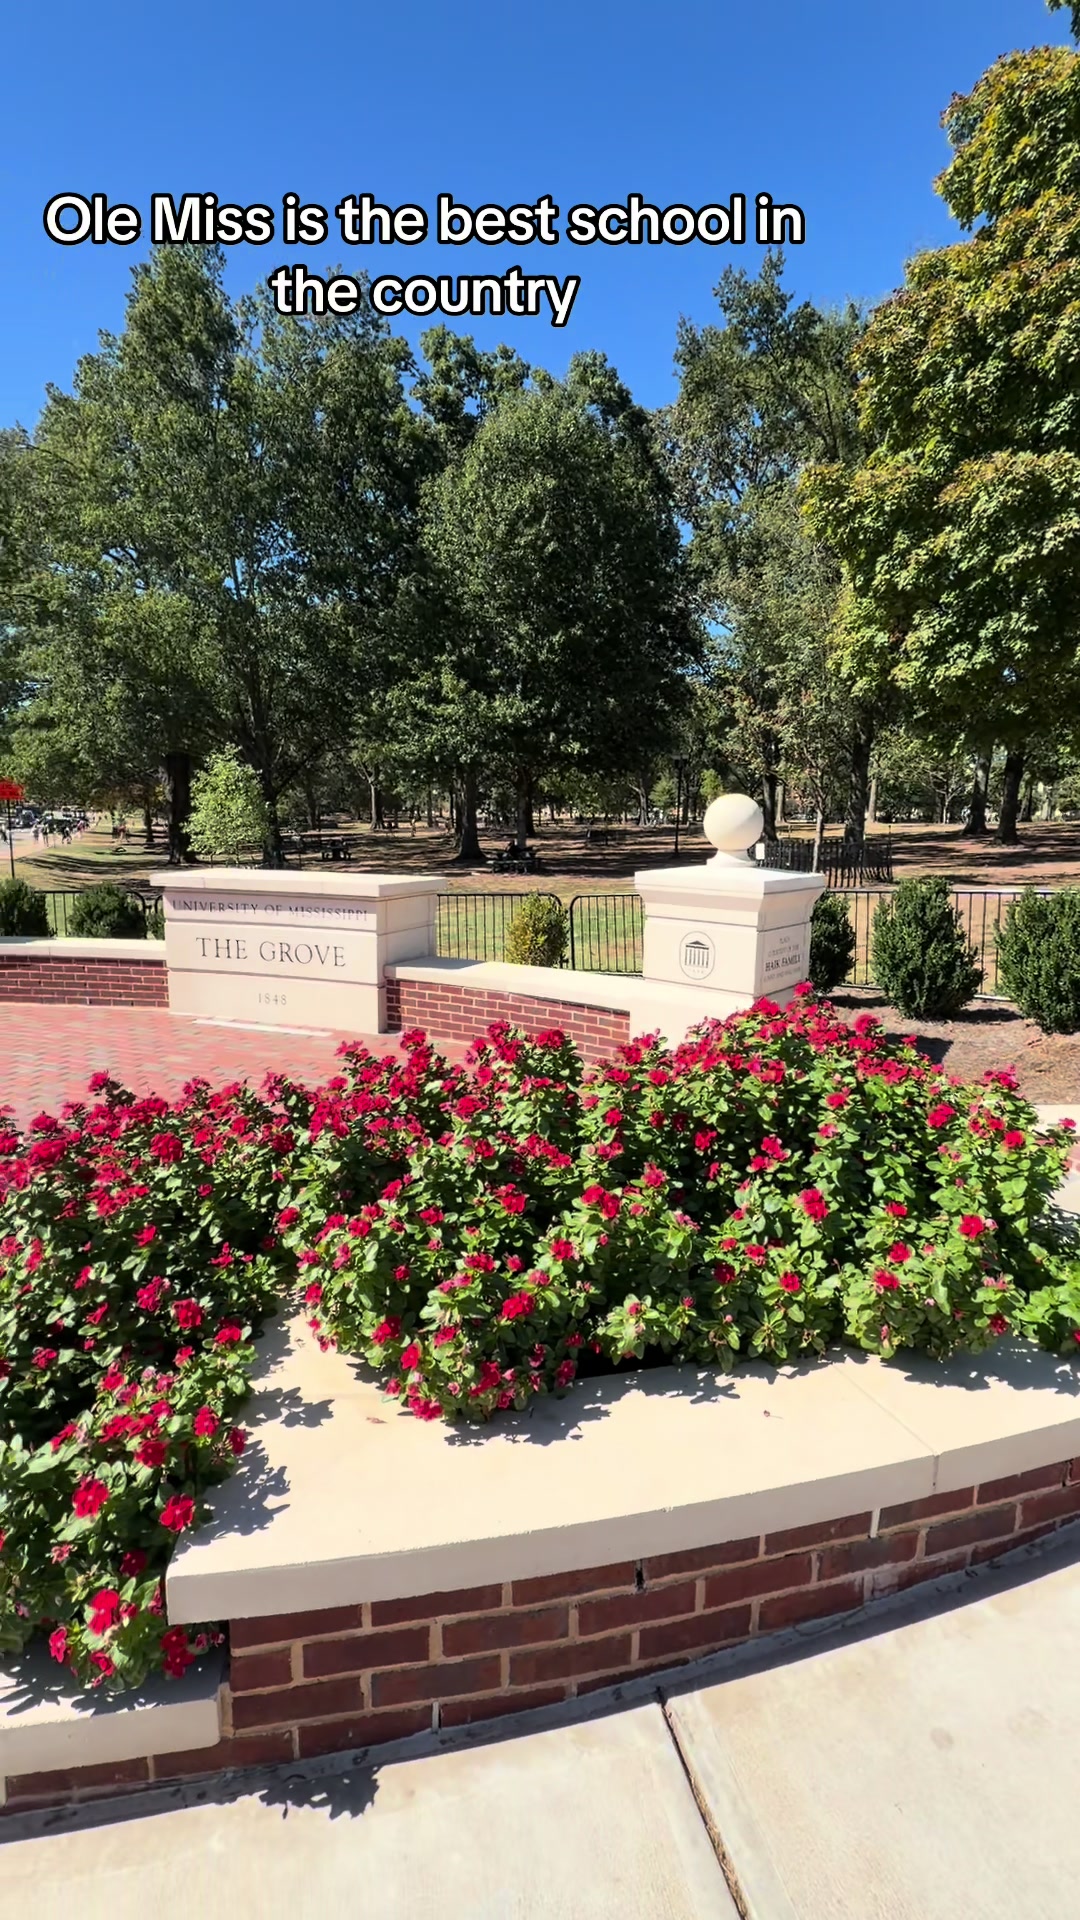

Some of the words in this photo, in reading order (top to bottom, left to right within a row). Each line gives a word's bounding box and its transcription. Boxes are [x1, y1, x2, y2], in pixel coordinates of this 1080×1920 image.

[172, 900, 259, 914] UNIVERSITY
[263, 903, 283, 916] OF
[288, 905, 368, 921] MISSISSIPPI
[196, 936, 248, 960] THE
[259, 941, 346, 967] GROVE
[258, 992, 287, 1006] 1848
